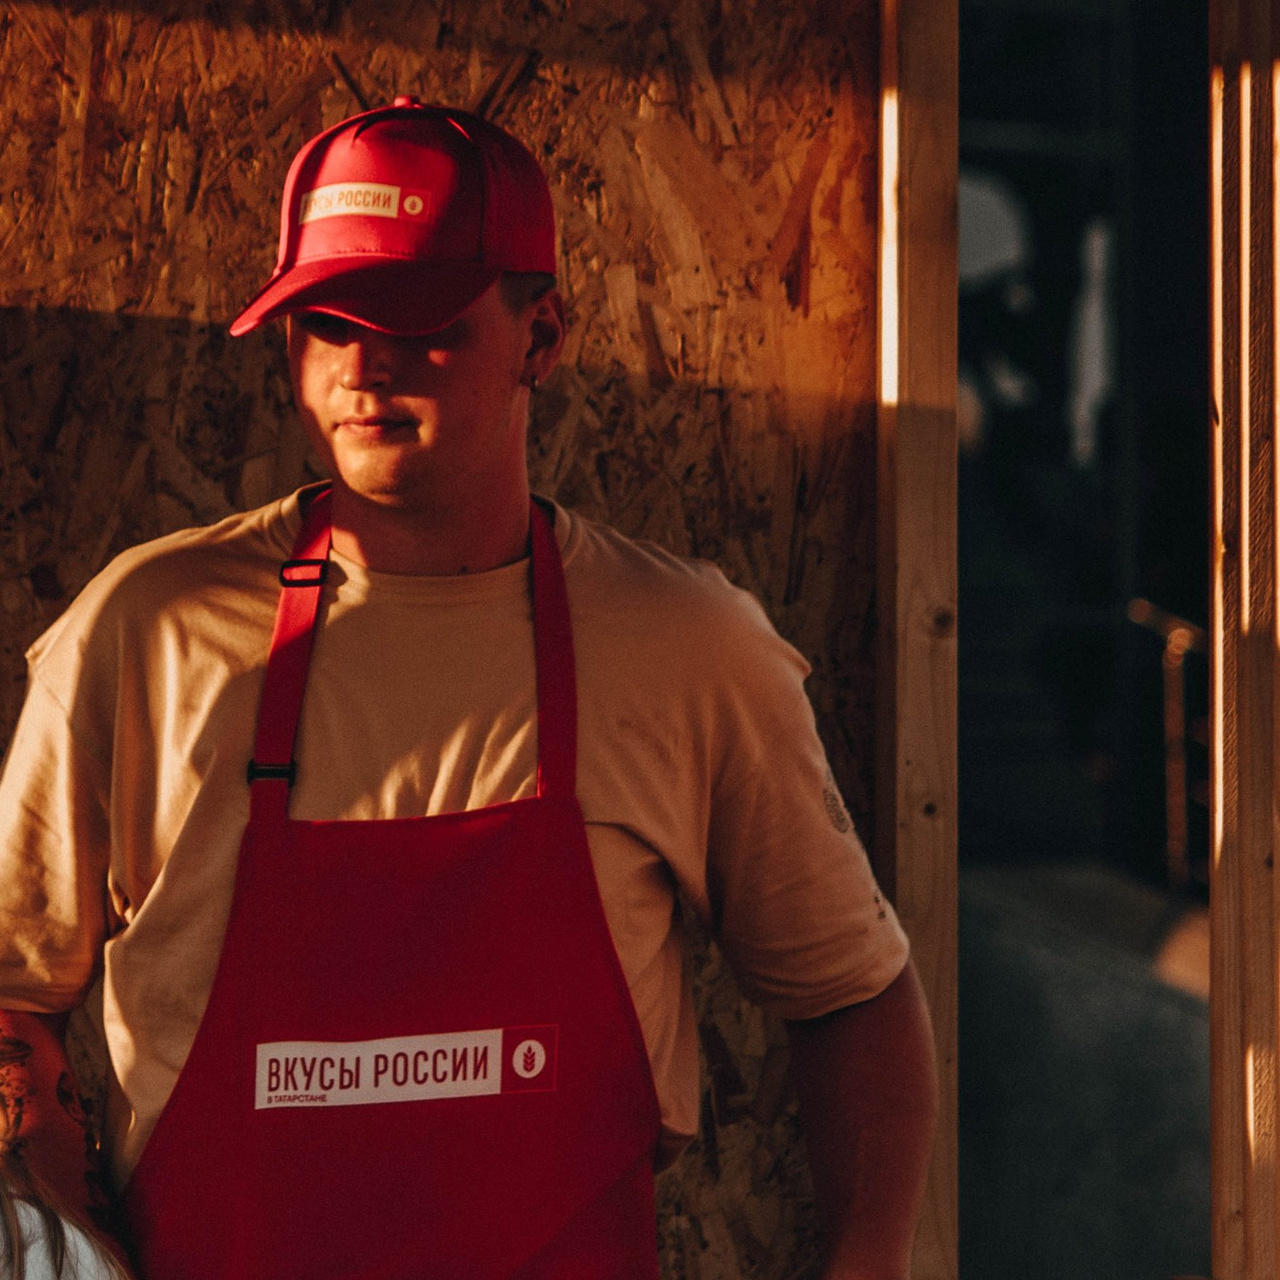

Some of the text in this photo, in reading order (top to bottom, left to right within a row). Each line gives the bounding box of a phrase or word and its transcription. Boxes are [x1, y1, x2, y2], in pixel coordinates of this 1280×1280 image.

[338, 189, 391, 209] РОССИИ
[267, 1045, 489, 1092] ВКУСЫ РОССИИ
